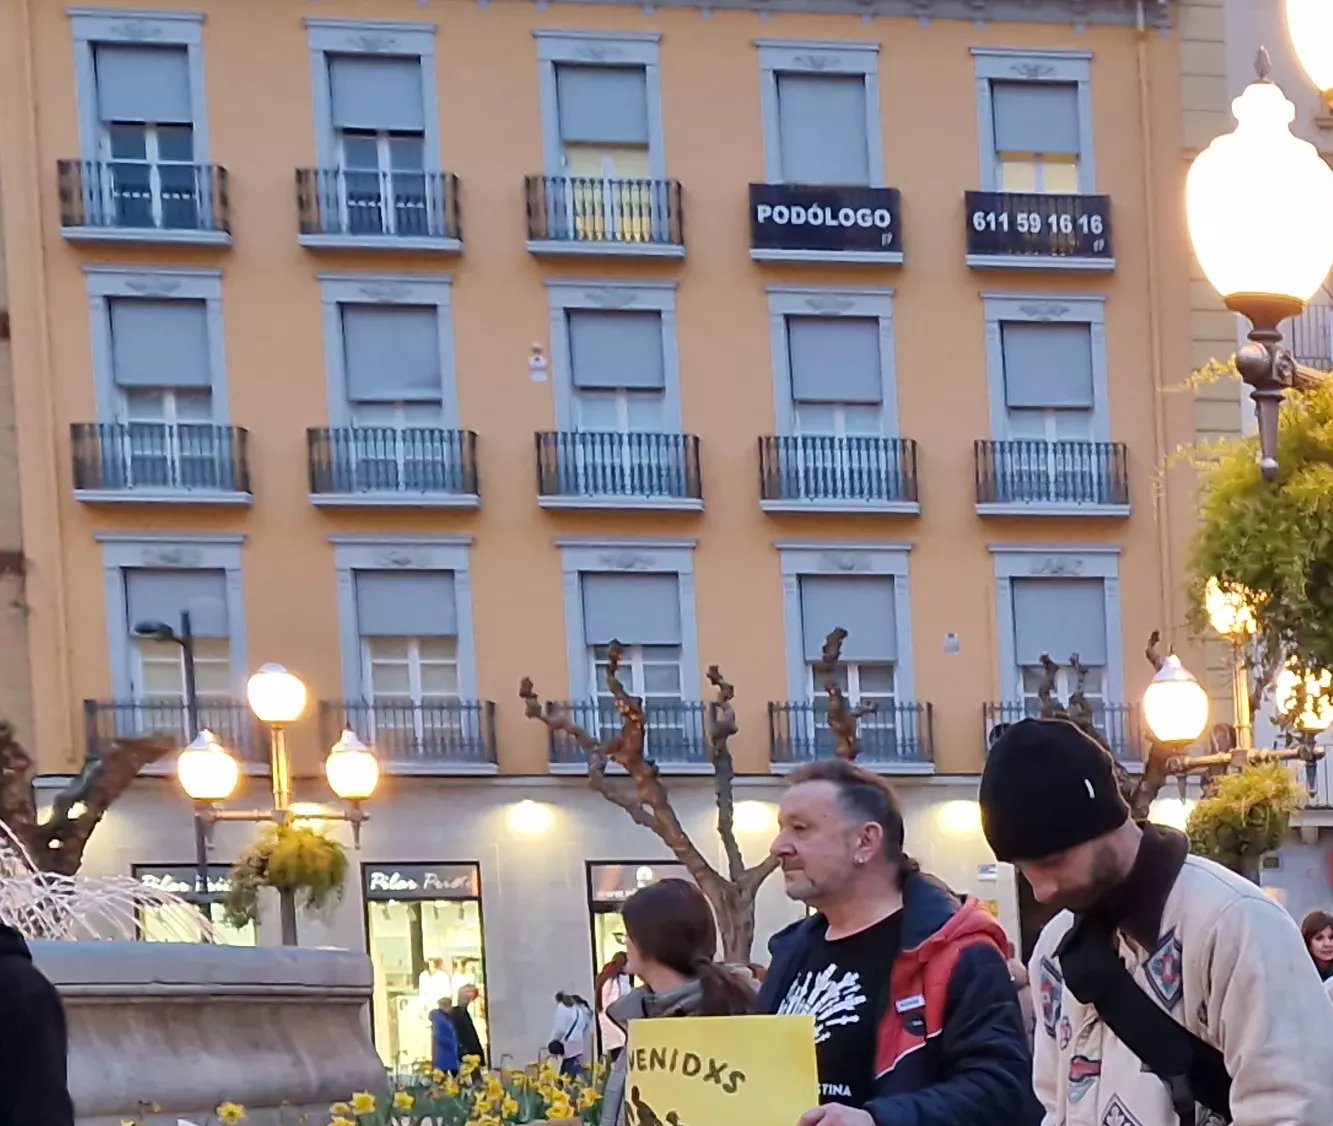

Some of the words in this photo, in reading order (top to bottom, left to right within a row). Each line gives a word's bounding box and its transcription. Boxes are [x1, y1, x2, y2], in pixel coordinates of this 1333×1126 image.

[757, 203, 891, 228] PODÓLOGO
[972, 211, 1009, 231] 611
[1016, 212, 1042, 233] 59
[1048, 213, 1073, 234] 16
[1078, 214, 1103, 235] 16
[369, 871, 418, 891] Pilar
